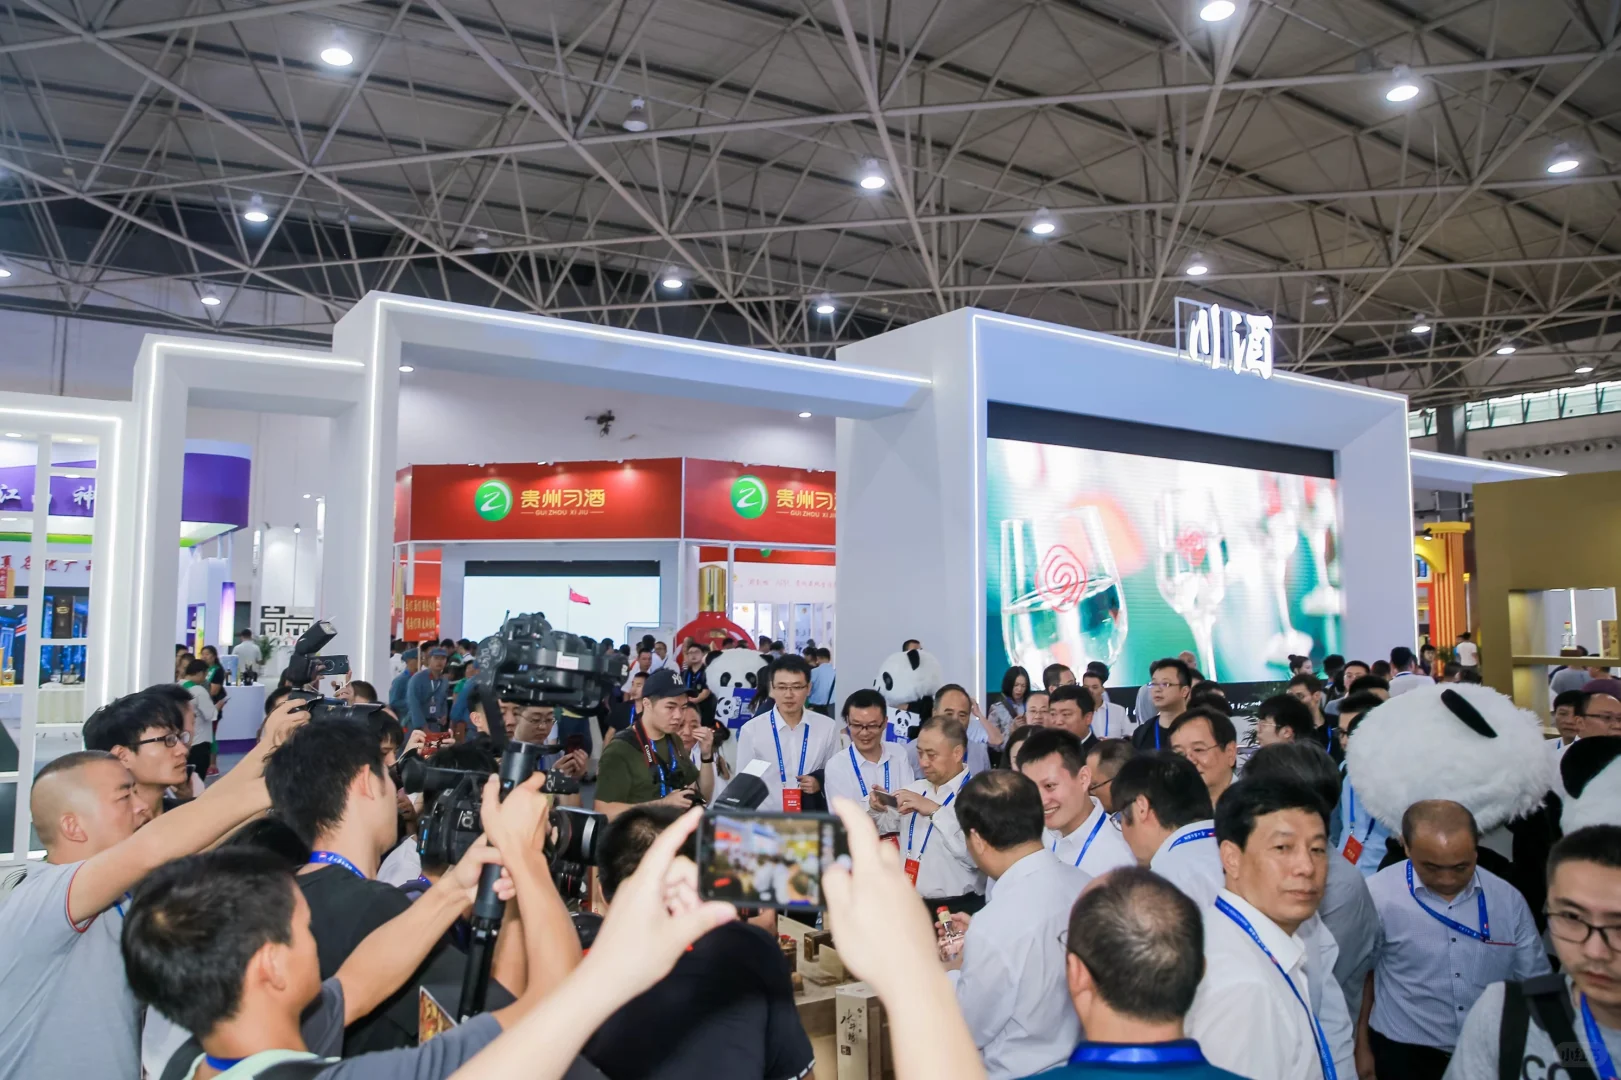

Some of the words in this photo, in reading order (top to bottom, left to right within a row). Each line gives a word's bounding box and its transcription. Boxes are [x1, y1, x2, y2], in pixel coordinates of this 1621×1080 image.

[520, 488, 606, 508] 贵州习酒
[776, 488, 836, 511] 贵州习
[802, 510, 820, 518] ZHOU
